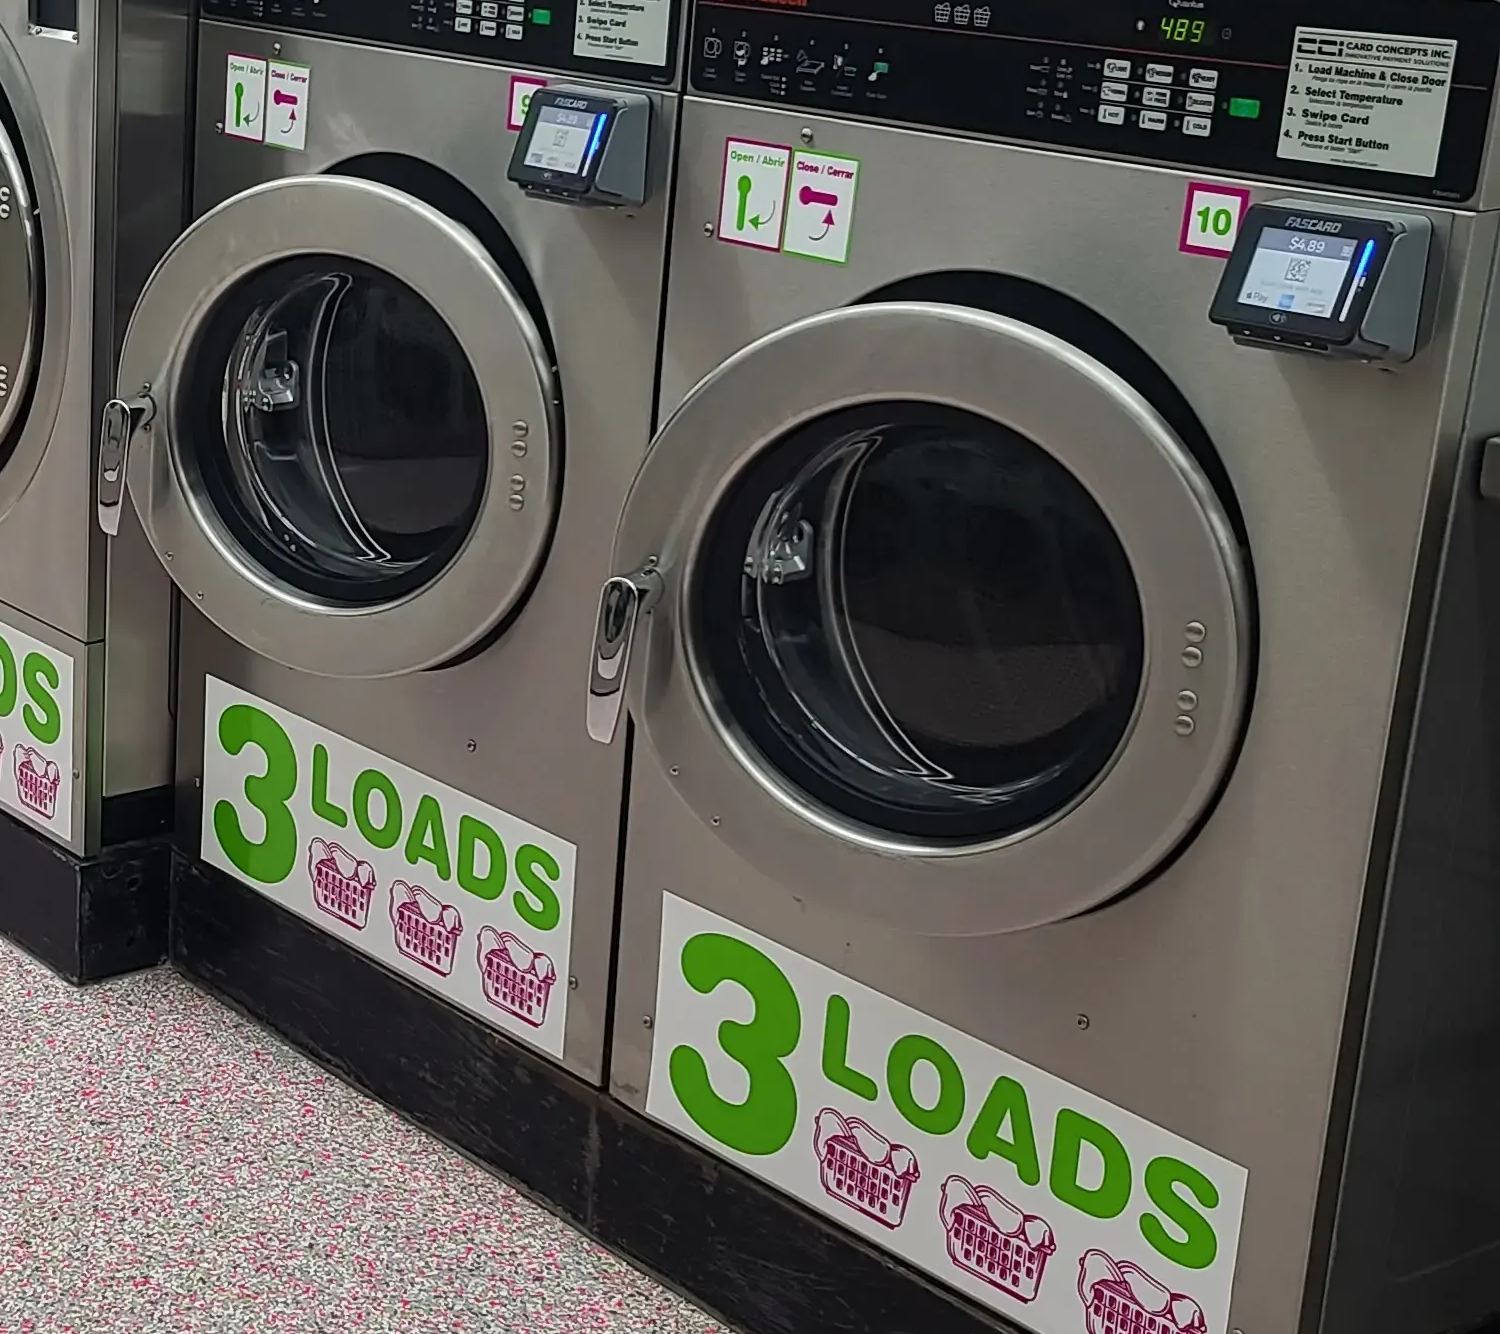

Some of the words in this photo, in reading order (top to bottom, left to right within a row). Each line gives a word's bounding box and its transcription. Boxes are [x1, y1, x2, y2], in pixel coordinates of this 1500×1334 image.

[609, 18, 627, 28] Card
[1160, 17, 1205, 43] 489
[1345, 52, 1381, 62] INNOVATIVE
[1382, 55, 1413, 64] PAYMENT
[1413, 58, 1450, 68] SOLUTIONS
[1346, 41, 1374, 54] CARD
[1376, 44, 1429, 58] CONCEPTS
[1431, 49, 1452, 60] INC.
[230, 63, 244, 72] Open
[1294, 63, 1303, 73] 1.
[1308, 64, 1332, 75] Load
[1334, 68, 1376, 81] Machine
[1378, 71, 1386, 82] &
[1390, 72, 1419, 85] Close
[1421, 75, 1447, 87] Door
[554, 97, 588, 110] FASCARD
[1290, 85, 1300, 95] 2.
[1305, 86, 1336, 99] Select
[1339, 89, 1403, 106] Temperature
[1286, 107, 1296, 117] 3.
[1301, 108, 1337, 122] Swipe
[1340, 113, 1370, 126] Card
[1283, 129, 1293, 139] 4.
[1297, 131, 1325, 143] Press
[1327, 134, 1353, 146] Start
[1355, 138, 1389, 151] Button
[730, 150, 754, 163] Open
[762, 155, 785, 168] Abrir
[796, 160, 819, 174] Close
[826, 166, 854, 180] Cerrar
[1197, 205, 1232, 236] 10
[1285, 216, 1343, 234] FASCARD
[1288, 236, 1326, 254] $4.89
[1253, 291, 1269, 304] Pay
[213, 703, 299, 885] 3
[310, 742, 563, 933] LOADS
[668, 931, 803, 1157] 3
[821, 993, 1221, 1271] LOADS
